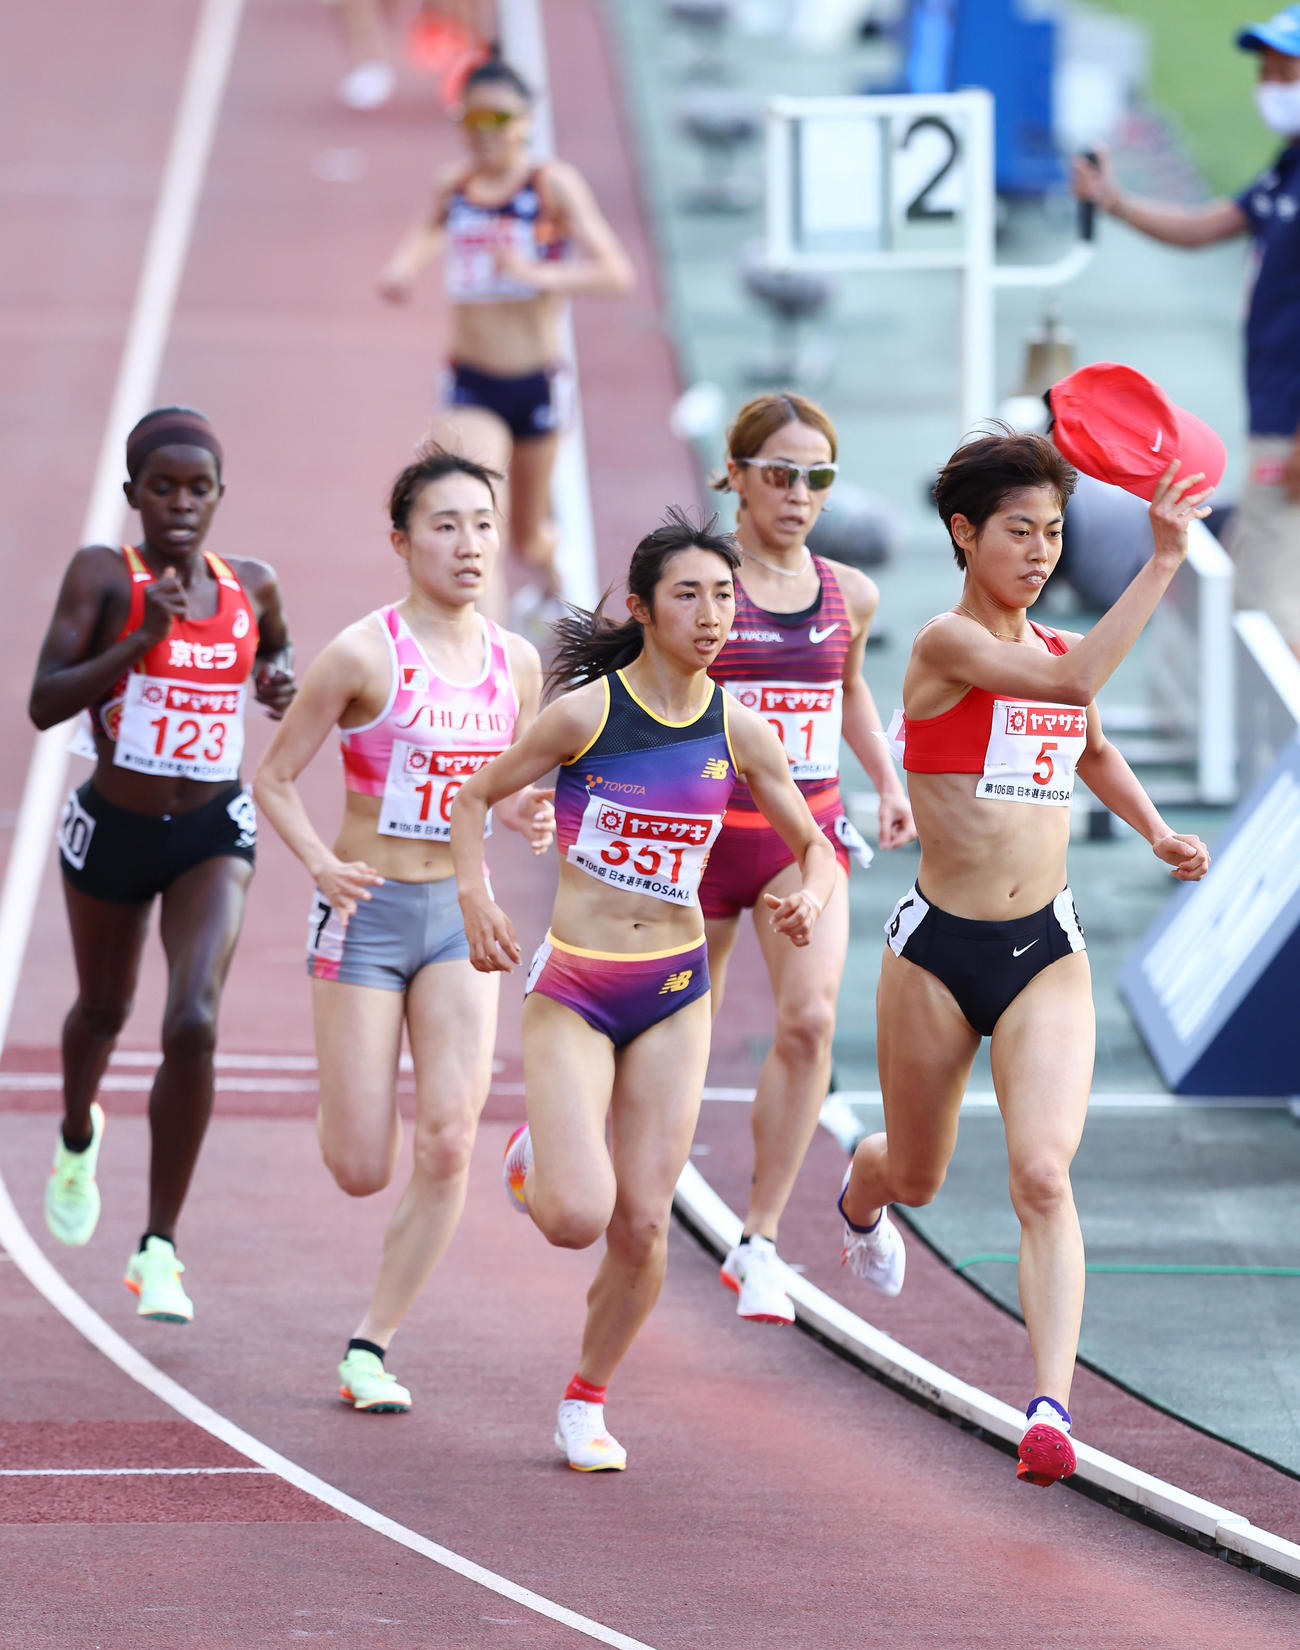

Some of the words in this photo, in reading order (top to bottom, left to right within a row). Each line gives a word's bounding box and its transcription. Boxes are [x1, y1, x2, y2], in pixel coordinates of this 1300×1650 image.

[902, 115, 961, 222] 2
[168, 639, 237, 669] 京セラ
[169, 688, 239, 712] ヤマザキ
[765, 691, 832, 710] ヤマザキ
[1029, 713, 1086, 732] ヤマザキ
[151, 716, 227, 761] 123
[1032, 742, 1058, 786] 5
[602, 780, 647, 796] TOYOTA
[984, 783, 1015, 796] 第106回
[629, 817, 708, 841] ヤマザキ
[314, 902, 332, 950] 7
